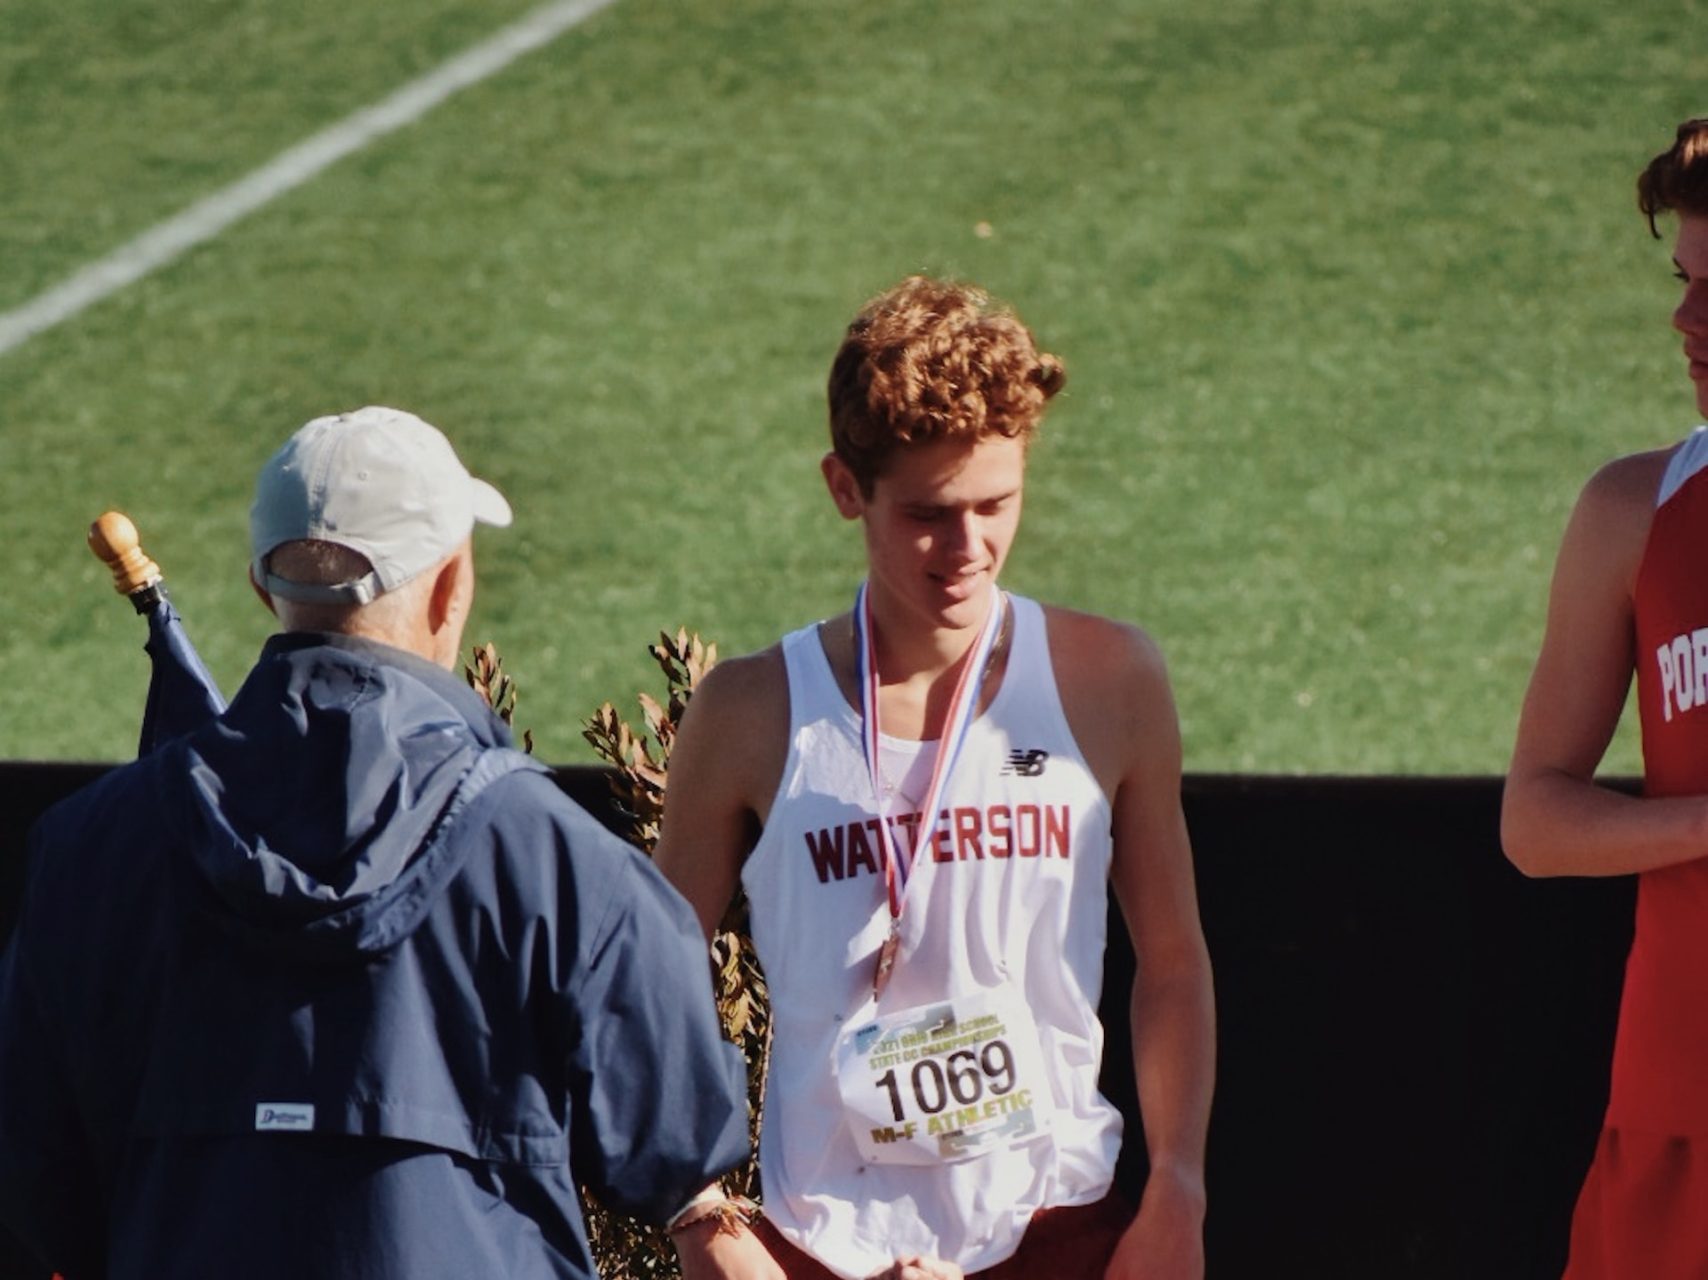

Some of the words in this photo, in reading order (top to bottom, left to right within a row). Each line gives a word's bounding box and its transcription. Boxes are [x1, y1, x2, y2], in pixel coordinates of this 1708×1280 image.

[804, 804, 1070, 884] WATTERSON
[869, 1053, 902, 1070] STATE
[902, 1048, 919, 1063] CC
[920, 1024, 1006, 1056] CHAMPIONSHIPS
[875, 1040, 1016, 1122] 1069
[870, 1121, 917, 1144] M-F
[927, 1089, 1033, 1136] ATHLETIC
